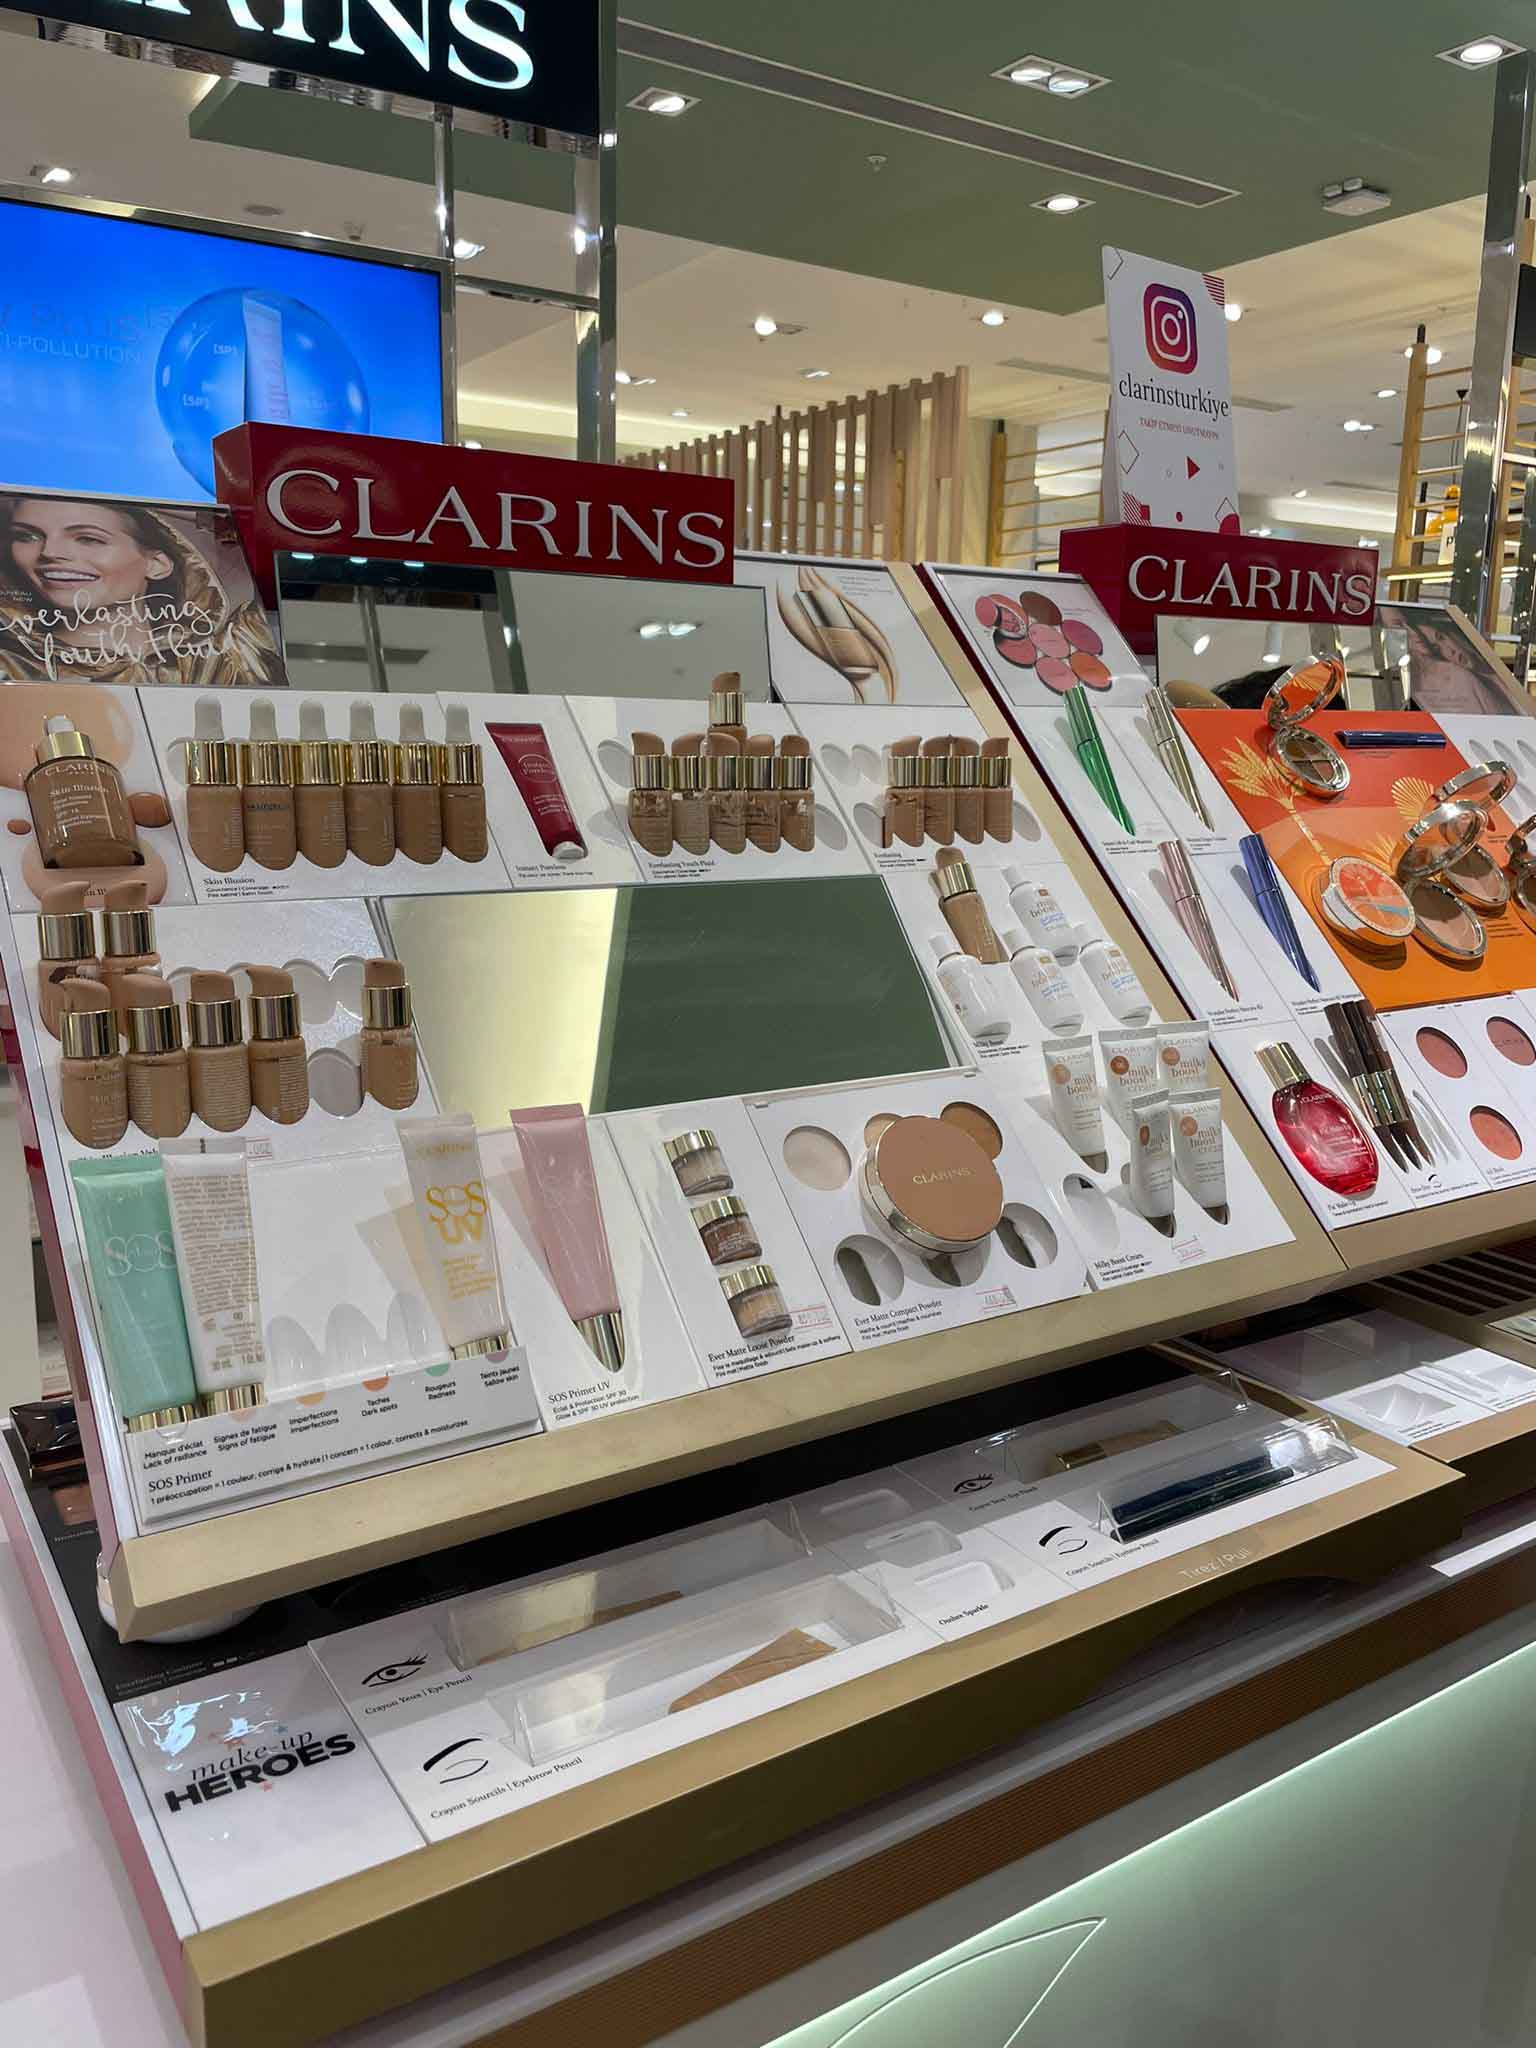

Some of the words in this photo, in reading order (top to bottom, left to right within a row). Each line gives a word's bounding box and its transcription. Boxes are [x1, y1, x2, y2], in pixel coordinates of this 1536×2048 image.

[1119, 372, 1229, 422] clarinsturkiye
[266, 469, 726, 568] CLARINS
[1128, 555, 1372, 616] CLARINS
[203, 877, 222, 885] Skin
[224, 877, 255, 885] Illusion
[1127, 1065, 1155, 1078] milky
[1171, 1065, 1201, 1079] boost
[1179, 1057, 1206, 1070] milky
[1074, 1072, 1097, 1086] milky
[1119, 1074, 1149, 1086] boost
[1066, 1082, 1094, 1097] boost
[1189, 1134, 1217, 1149] boost
[912, 1167, 972, 1185] CLARINS
[426, 1180, 488, 1222] SOS
[438, 1215, 485, 1244] UV
[104, 1230, 176, 1277] SOS
[854, 1315, 870, 1327] Ever
[870, 1309, 889, 1321] Matte
[889, 1302, 919, 1318] Compact
[918, 1298, 943, 1312] Powder
[708, 1352, 726, 1362] Ever
[726, 1346, 747, 1358] Matte
[748, 1341, 769, 1353] Loose
[768, 1334, 795, 1348] Powder
[480, 1369, 499, 1380] Teints
[500, 1365, 520, 1376] jaunes
[484, 1378, 505, 1388] Sallow
[506, 1374, 519, 1383] skin
[425, 1380, 456, 1394] Rougeurs
[428, 1389, 456, 1401] Redness
[548, 1391, 568, 1404] SOS
[568, 1384, 596, 1399] Primer
[597, 1379, 611, 1392] UV
[361, 1407, 378, 1417] Dark
[379, 1402, 398, 1414] spots
[367, 1396, 391, 1407] Taches
[289, 1408, 338, 1425] Imperfections
[290, 1417, 340, 1434] Imperfections
[214, 1432, 239, 1444] Signes
[240, 1428, 250, 1437] de
[251, 1423, 277, 1436] fatigue
[217, 1441, 239, 1452] Signs
[240, 1437, 249, 1445] of
[249, 1432, 276, 1445] fatigue
[143, 1459, 163, 1470] Lack
[164, 1456, 173, 1465] of
[174, 1449, 208, 1463] radiance
[144, 1447, 177, 1460] Manque
[156, 1484, 213, 1504] préoccupation
[258, 1466, 285, 1479] corrige
[286, 1463, 292, 1472] &
[292, 1455, 321, 1471] hydrate
[330, 1447, 358, 1460] concern
[395, 1430, 424, 1444] corrects
[425, 1429, 430, 1437] &
[148, 1476, 173, 1493] SOS
[175, 1468, 214, 1487] Primer
[1179, 1562, 1217, 1579] Tirez
[1224, 1548, 1250, 1564] Pull
[962, 1604, 989, 1617] Sparkle
[365, 1701, 398, 1715] Crayon
[399, 1693, 421, 1704] Yeux
[428, 1686, 445, 1695] Eye
[445, 1675, 473, 1688] Pencil
[191, 1730, 313, 1781] make-up
[164, 1733, 356, 1813] HEROES
[430, 1802, 467, 1819] Crayon
[468, 1784, 506, 1806] Sourcils
[512, 1769, 552, 1788] Eyebrow
[553, 1756, 583, 1772] Pencil
